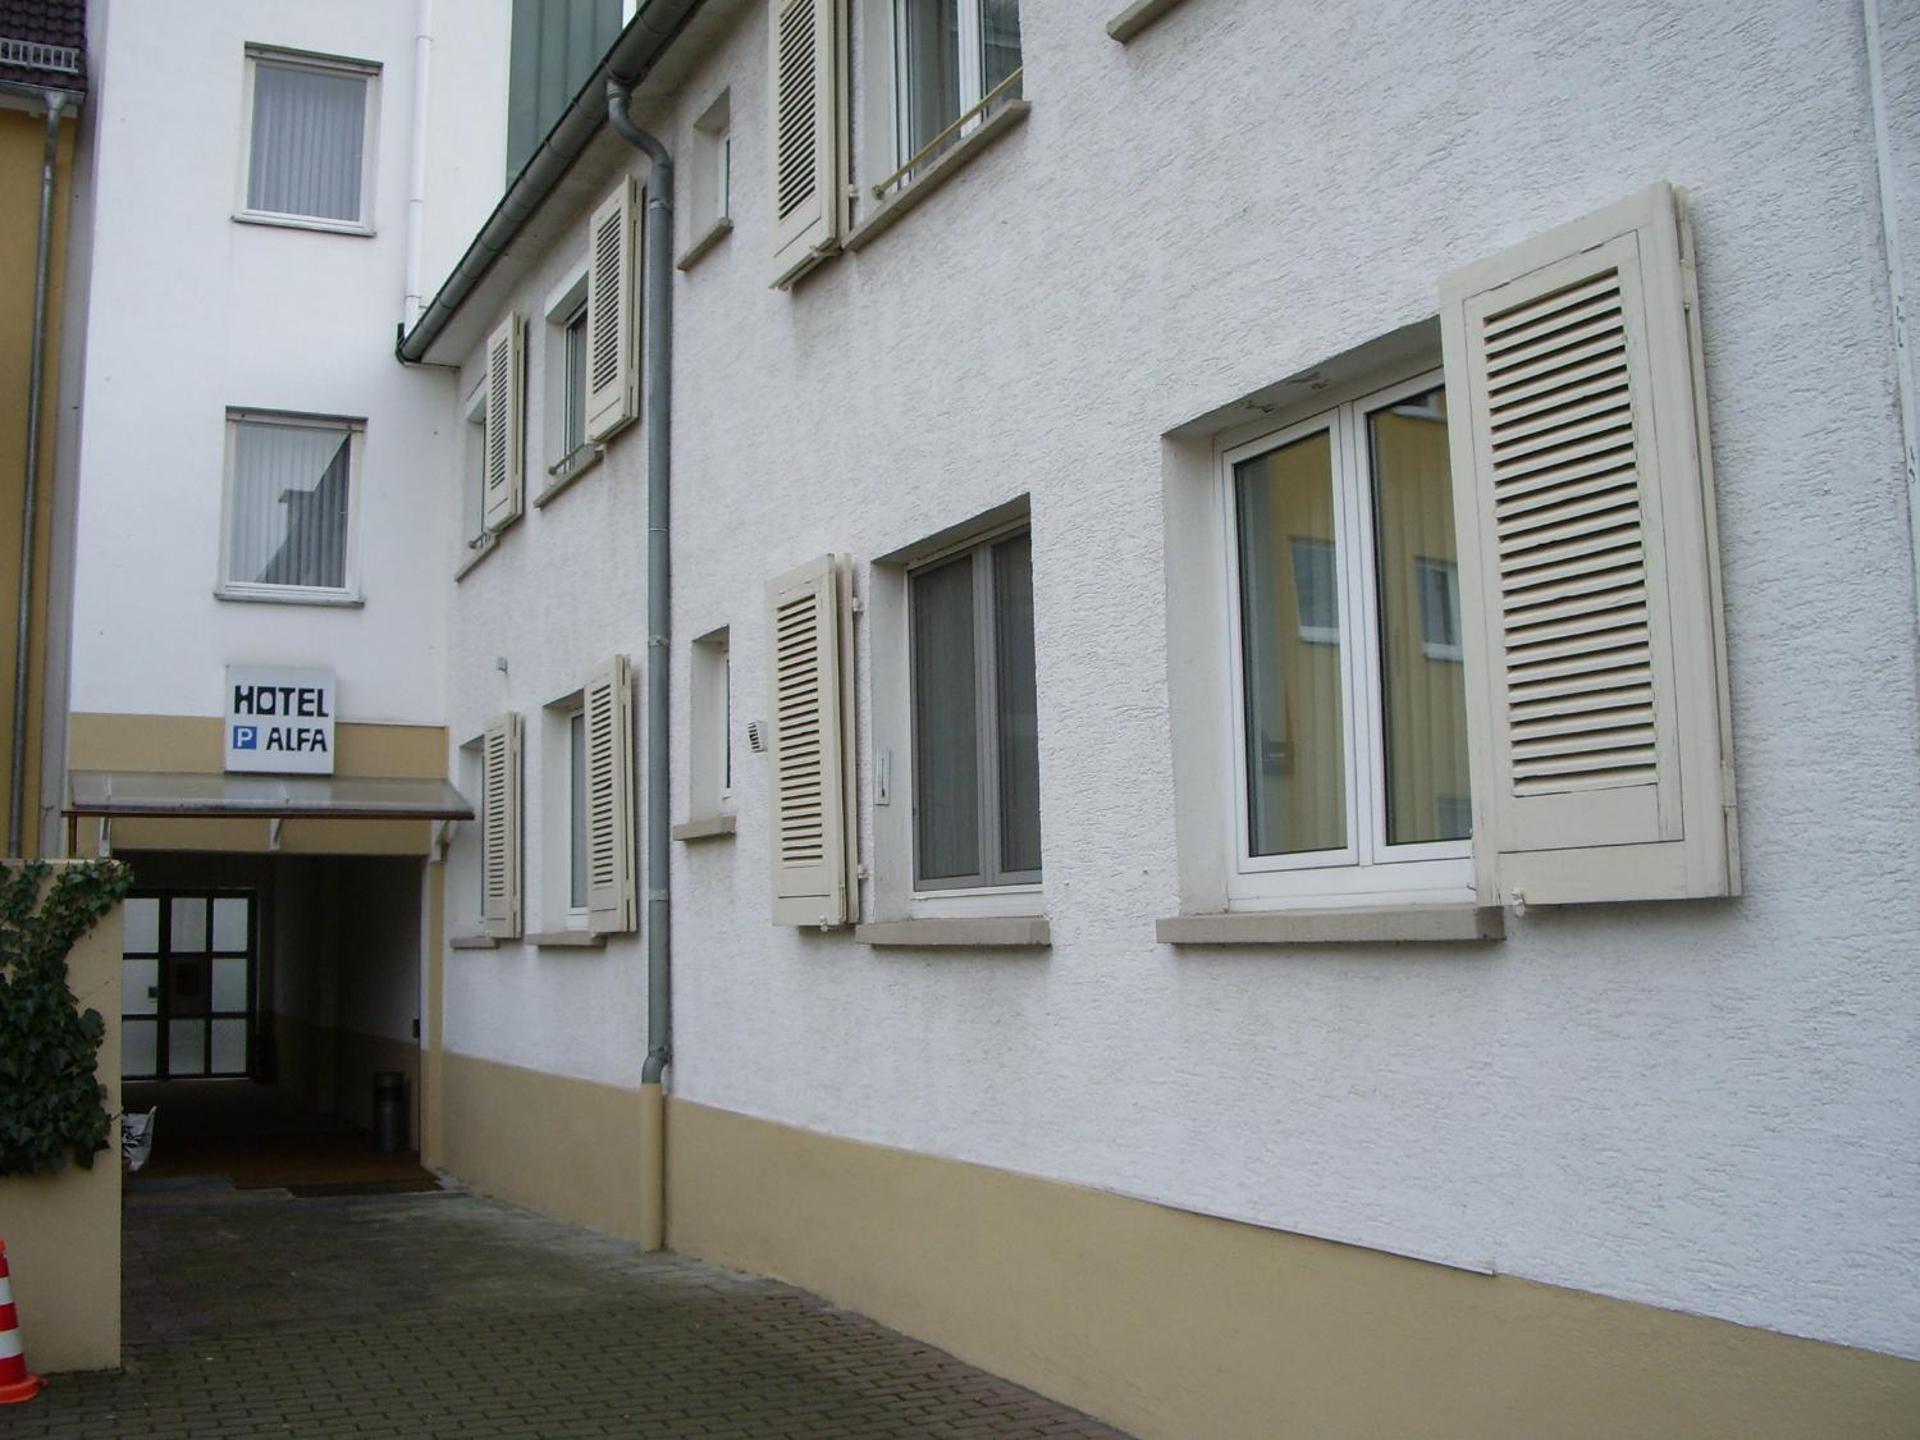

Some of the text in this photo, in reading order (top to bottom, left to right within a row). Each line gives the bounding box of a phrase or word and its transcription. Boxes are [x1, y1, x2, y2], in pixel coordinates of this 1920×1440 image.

[234, 685, 329, 717] HOTEL
[236, 727, 327, 752] P ALFA
